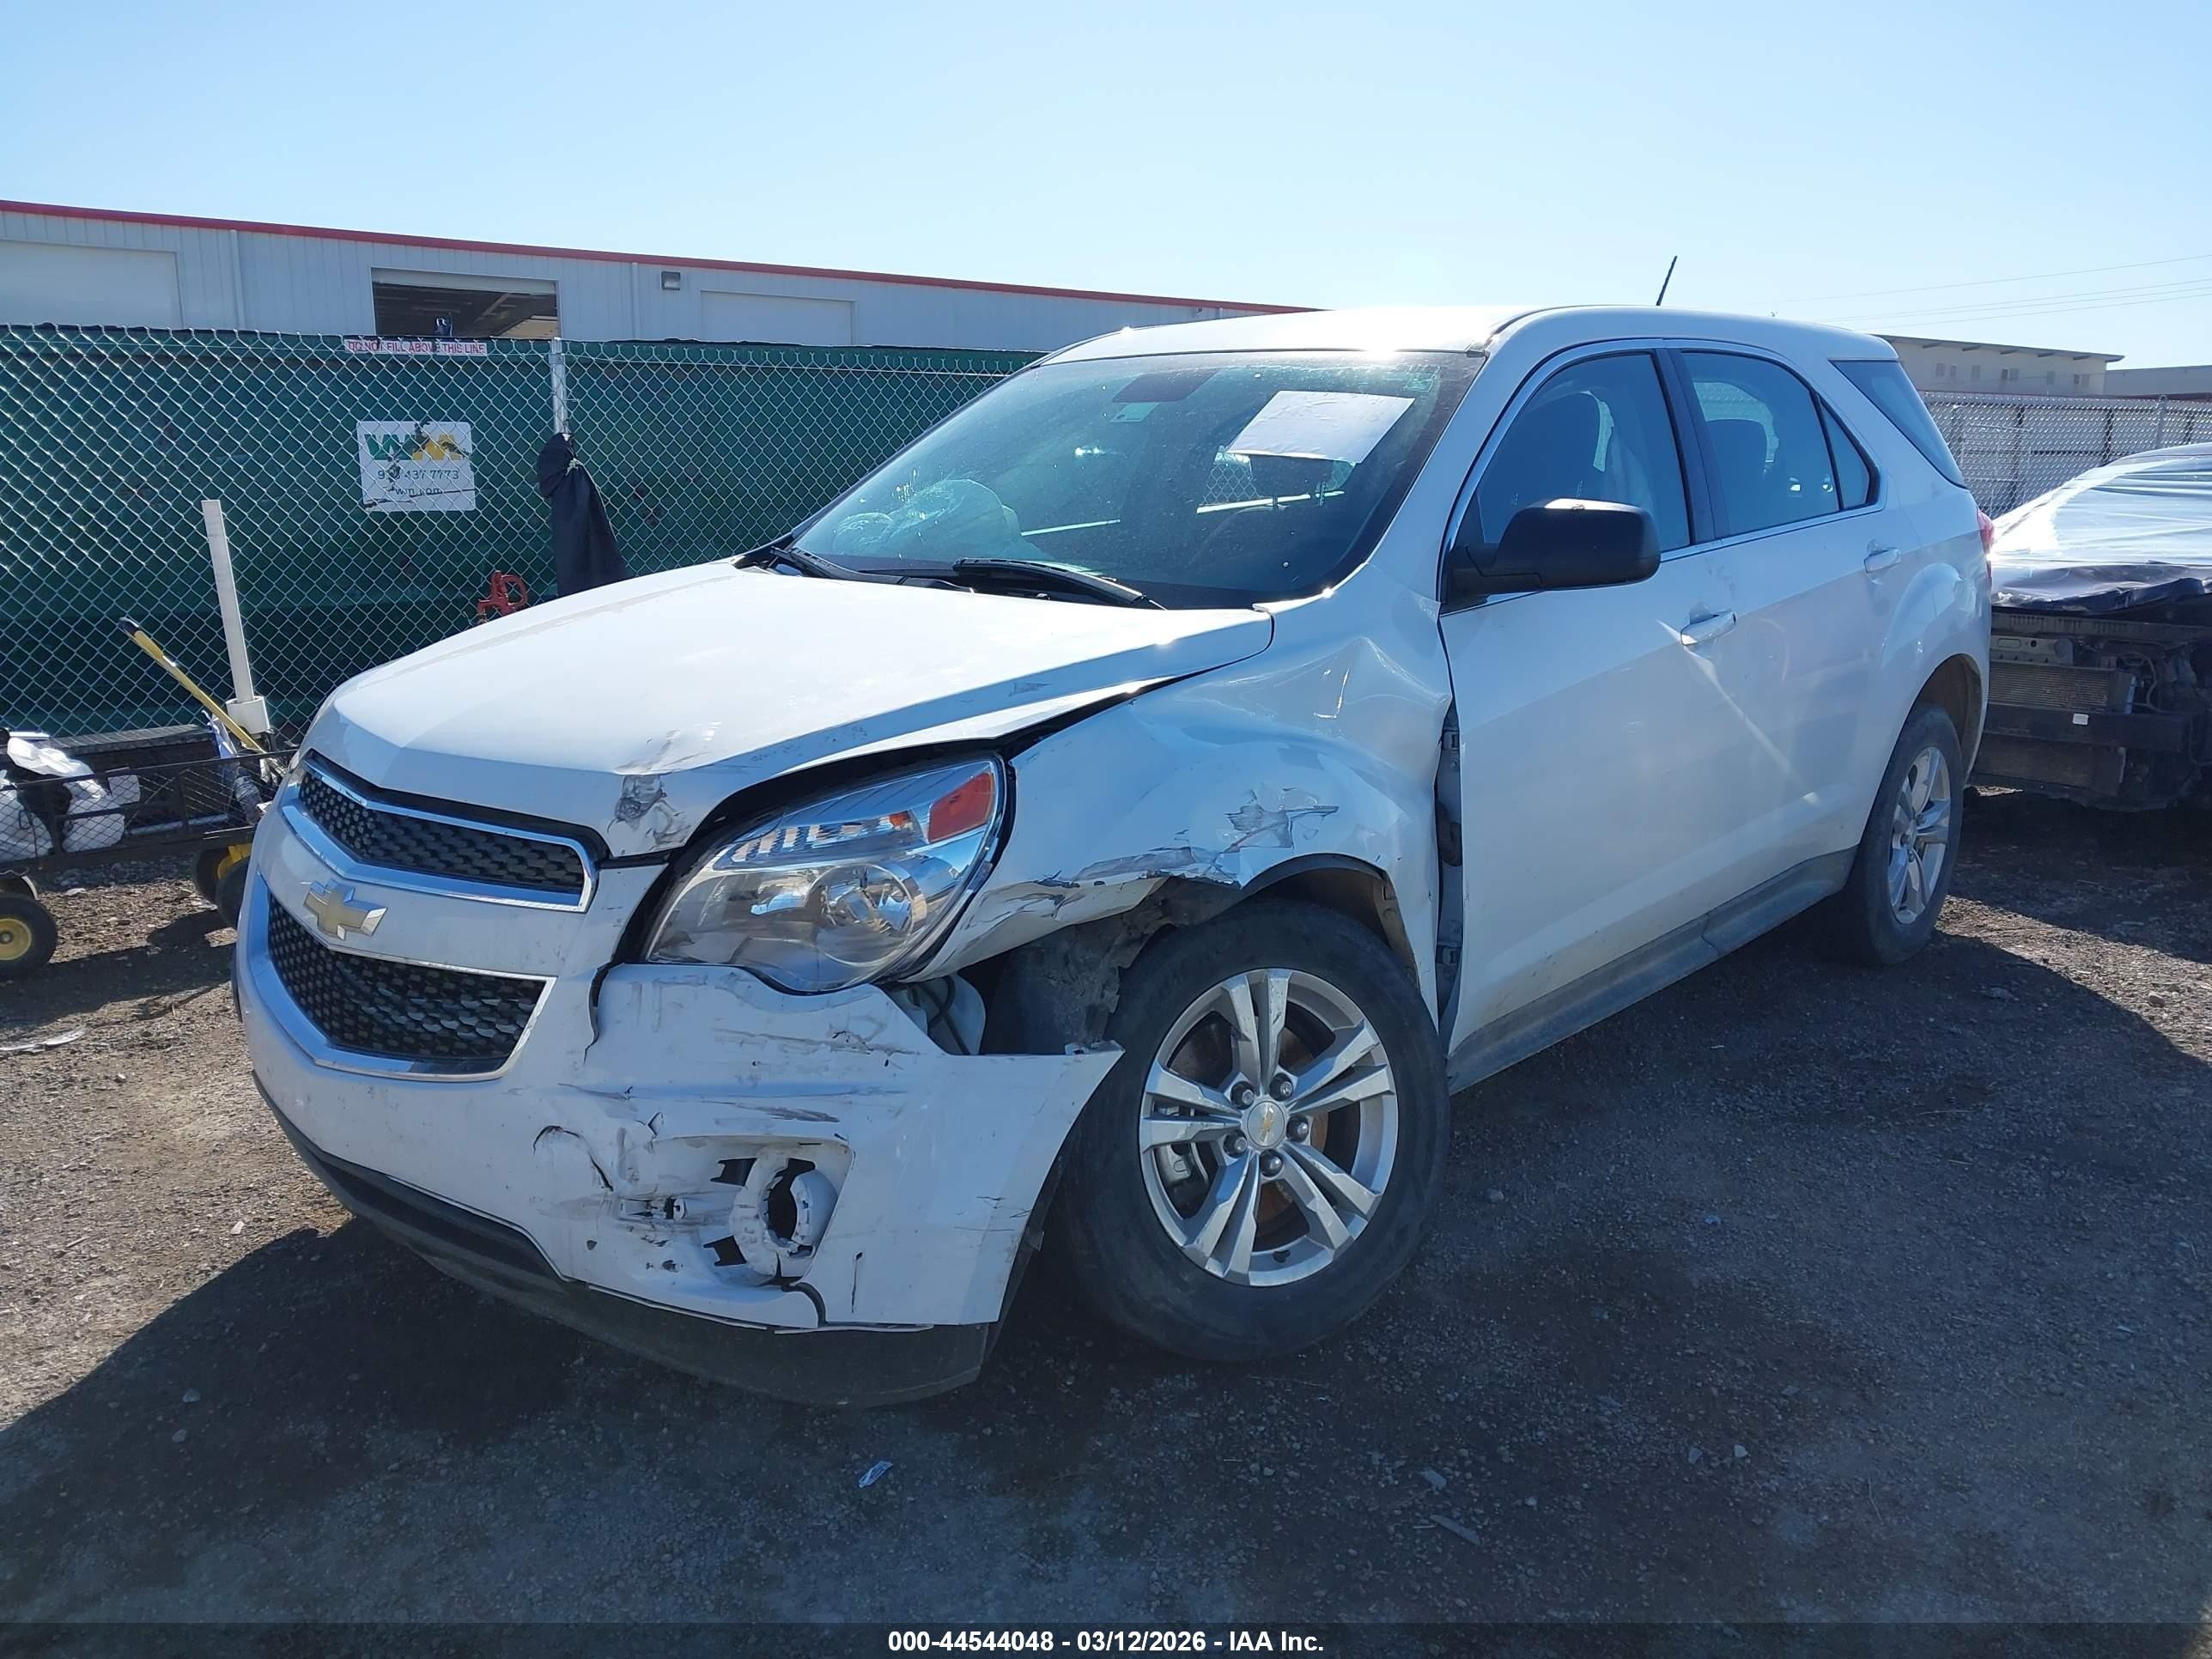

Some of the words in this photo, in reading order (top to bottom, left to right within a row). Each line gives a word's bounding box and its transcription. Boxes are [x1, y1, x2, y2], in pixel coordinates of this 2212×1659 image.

[348, 341, 362, 351] DO
[442, 343, 462, 354] THIS
[465, 343, 485, 354] LINE
